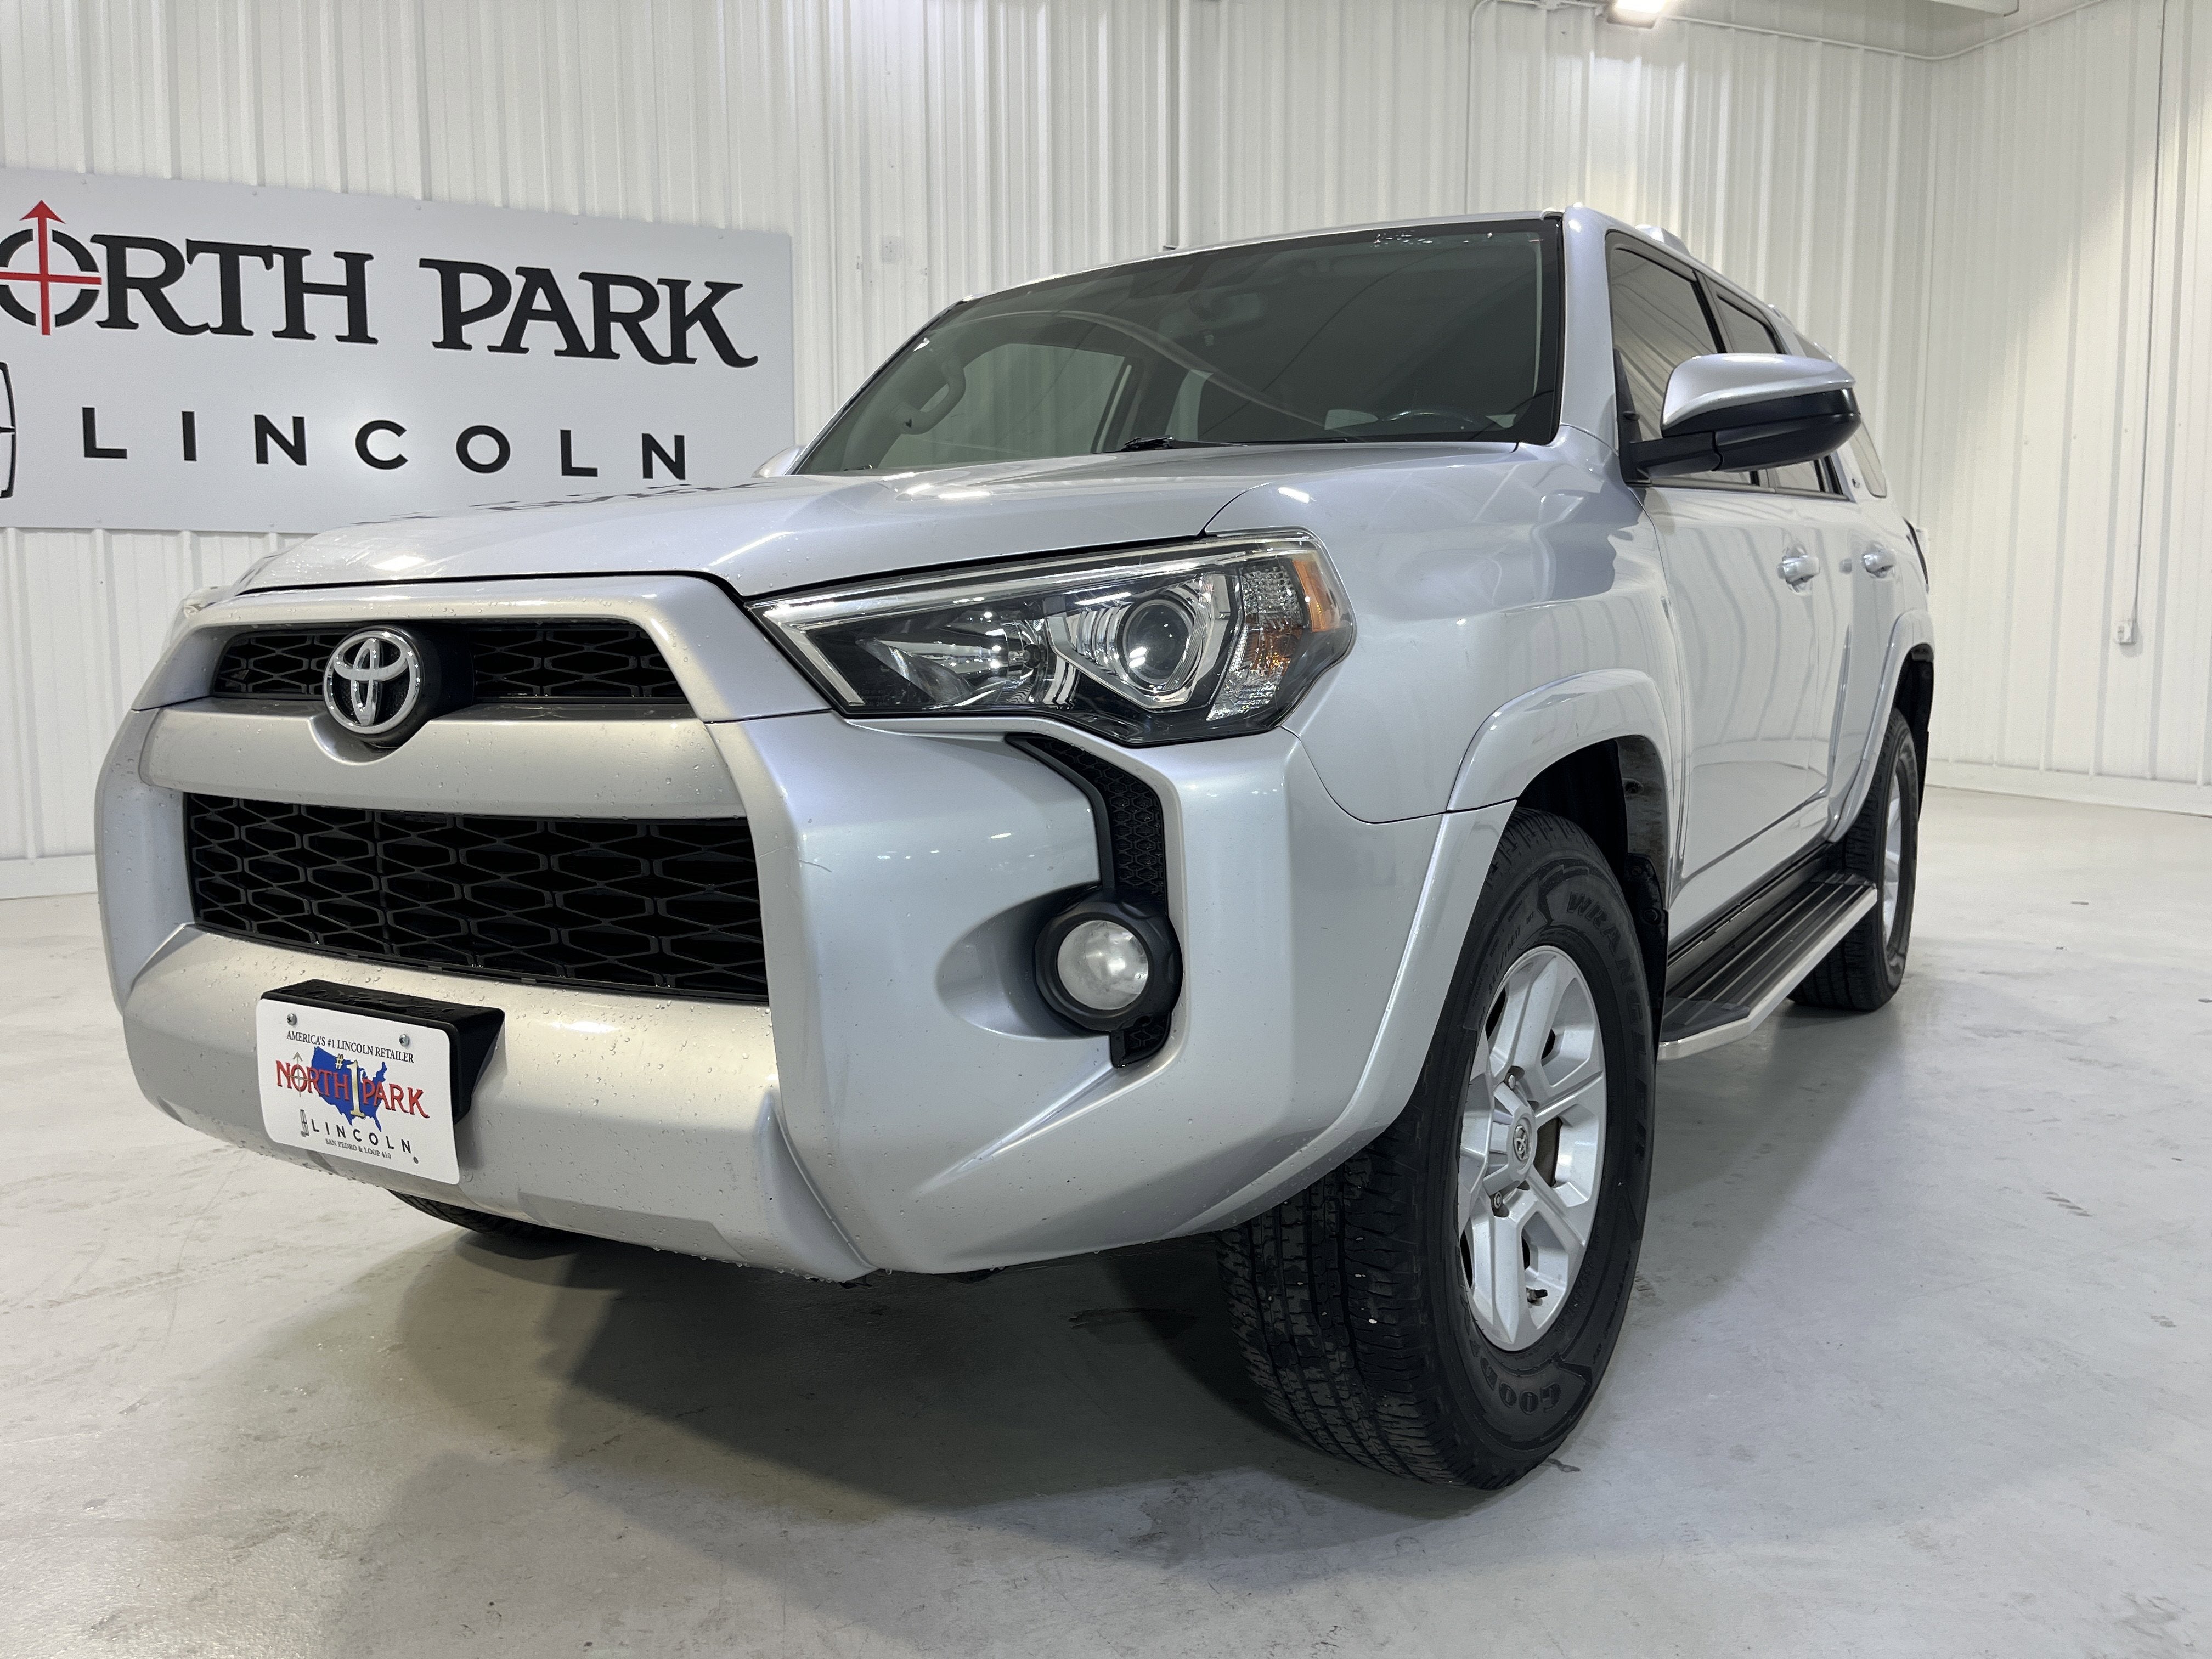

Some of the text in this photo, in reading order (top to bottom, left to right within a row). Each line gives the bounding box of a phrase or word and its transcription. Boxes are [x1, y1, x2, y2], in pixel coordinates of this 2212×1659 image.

[0, 228, 758, 368] ORTH PARK
[82, 406, 686, 481] LINCOLN
[286, 1030, 415, 1064] AMERICA'S #1 LINCOLN RETAILER
[275, 1060, 430, 1119] NORTH PARK
[311, 1119, 412, 1154] LINCOLN
[338, 1141, 358, 1151] PEDRO
[364, 1148, 380, 1156] LOOP
